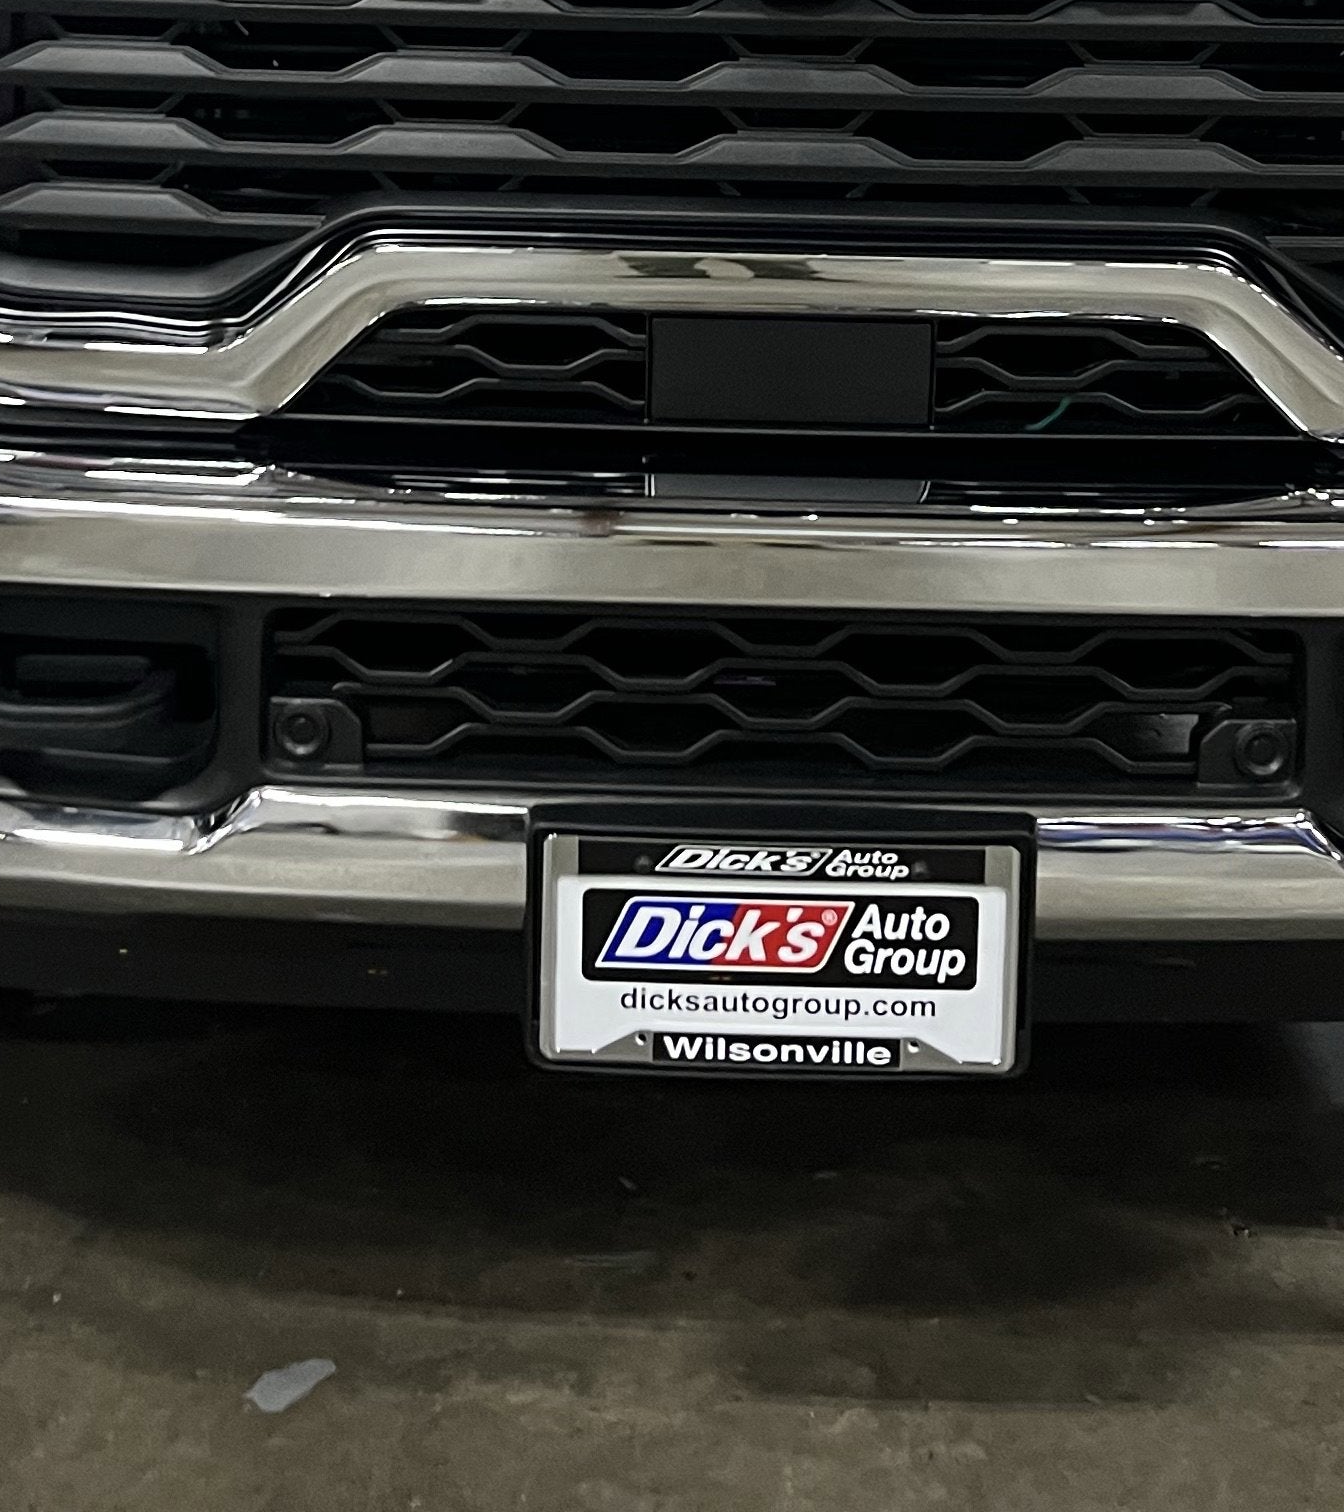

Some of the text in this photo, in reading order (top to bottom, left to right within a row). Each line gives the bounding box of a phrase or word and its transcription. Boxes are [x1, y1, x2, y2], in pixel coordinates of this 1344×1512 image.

[825, 862, 910, 881] Group
[836, 849, 899, 865] Auto
[615, 904, 951, 963] Dick's Auto
[844, 941, 966, 983] Group
[619, 986, 938, 1020] dicksautogroup.com
[662, 1035, 893, 1066] Wilsonville
